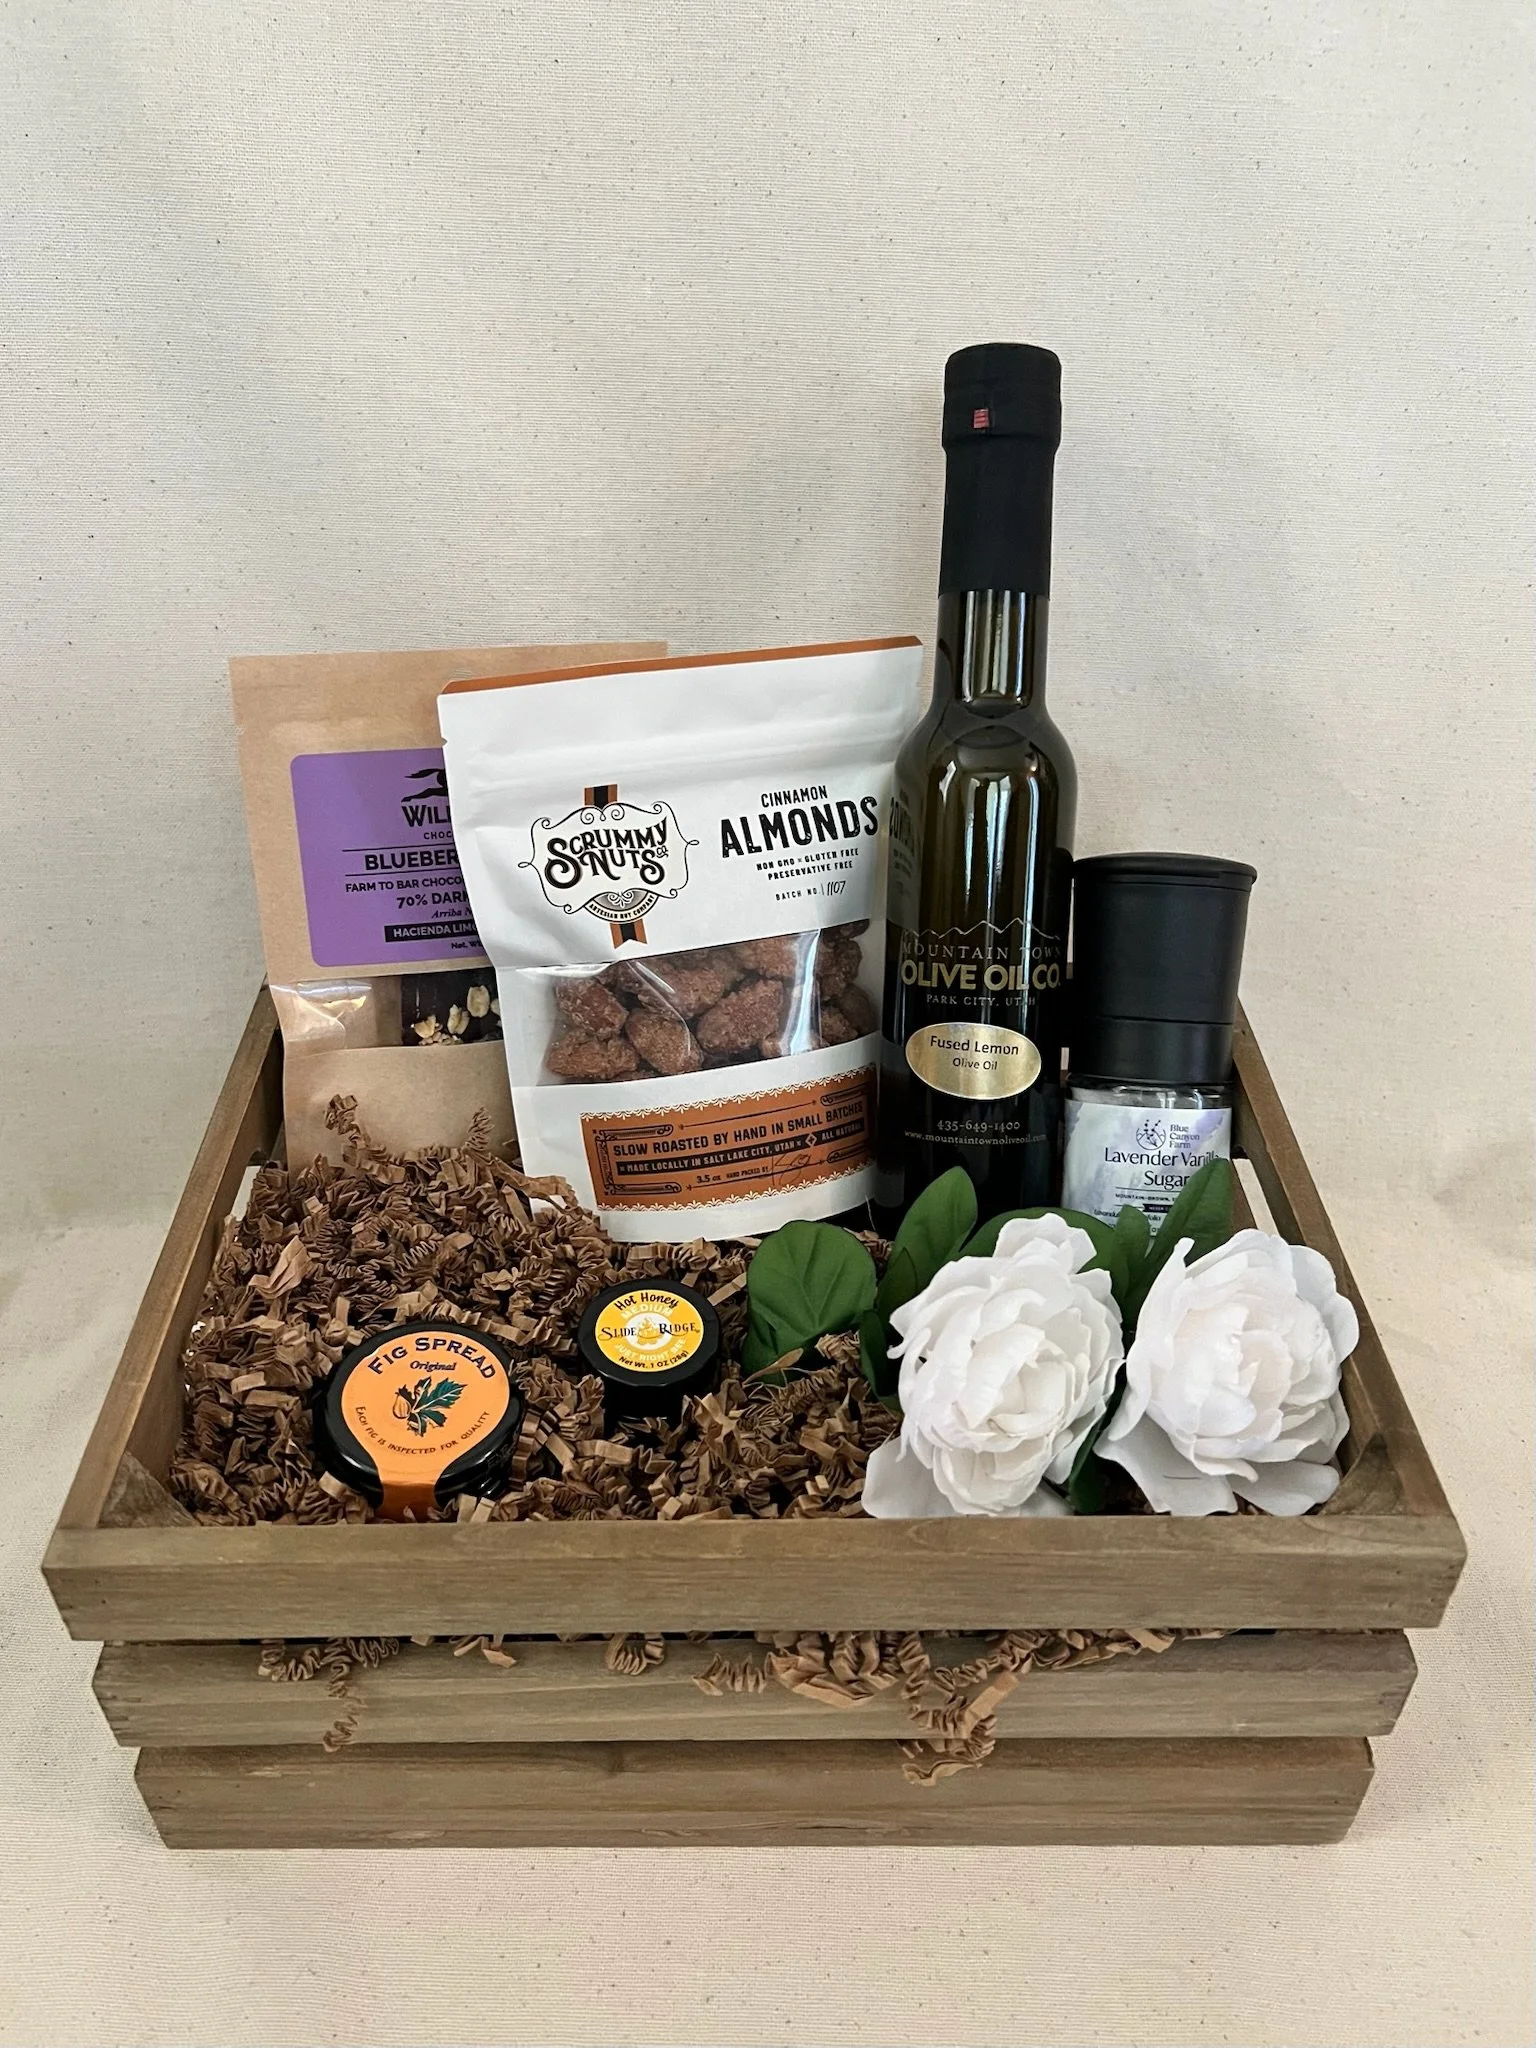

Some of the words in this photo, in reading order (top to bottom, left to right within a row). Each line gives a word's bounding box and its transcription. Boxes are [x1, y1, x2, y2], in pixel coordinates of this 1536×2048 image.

[761, 785, 828, 808] CINNAMON
[721, 796, 879, 858] ALMONDS
[544, 816, 668, 889] SCRUMMY
[756, 861, 775, 871] NON
[777, 858, 795, 867] GMO
[804, 851, 838, 863] GLUTEN
[840, 847, 859, 858] FREE
[577, 848, 666, 886] NUTS
[767, 863, 832, 880] PRESERVATIVE
[834, 860, 854, 870] FREE
[345, 882, 377, 893] FARM
[378, 880, 394, 891] TO
[396, 879, 420, 890] BAR
[775, 889, 803, 901] BATCH
[396, 893, 429, 910] 70%
[632, 894, 656, 916] COMPANY
[431, 908, 462, 919] Arriba
[393, 924, 452, 938] HACIENDA
[902, 942, 1009, 961] MOUNTAIN
[901, 958, 978, 991] OLIVE
[983, 963, 1030, 992] OIL
[926, 993, 958, 1006] PARK
[1005, 996, 1036, 1007] UTH
[930, 1035, 970, 1052] Fused
[974, 1040, 1020, 1056] Lemon
[952, 1057, 980, 1070] Olive
[982, 1060, 998, 1071] Oil
[613, 1143, 648, 1157] SLOW
[652, 1135, 709, 1154] ROASTED
[713, 1131, 729, 1146] BY
[734, 1124, 767, 1143] HAND
[771, 1120, 784, 1135] IN
[787, 1113, 823, 1132] SMALL
[825, 1101, 864, 1122] BATCHES
[936, 1118, 1021, 1133] 435-649-1400
[1170, 1124, 1189, 1132] Blue
[1169, 1132, 1200, 1142] Canyon
[1169, 1140, 1191, 1149] Farm
[627, 1163, 649, 1173] MADE
[651, 1159, 688, 1171] LOCALLY
[691, 1158, 702, 1167] IN
[703, 1154, 724, 1165] SALT
[727, 1149, 749, 1160] LAKE
[775, 1141, 795, 1152] UTAH
[821, 1131, 834, 1140] ALL
[1104, 1147, 1179, 1167] Lavender
[696, 1174, 711, 1184] 3.5
[1143, 1170, 1190, 1190] Sugar
[614, 1295, 637, 1311] Hot
[640, 1292, 679, 1309] Honey
[598, 1326, 636, 1341] SLIDE
[659, 1322, 700, 1337] RIDGE
[367, 1345, 408, 1375] FIG
[415, 1337, 496, 1379] SPREAD
[409, 1360, 457, 1373] Original
[618, 1356, 633, 1367] Net
[656, 1360, 670, 1368] OZ
[377, 1438, 386, 1446] IS
[387, 1442, 437, 1455] INSPECTED
[440, 1439, 459, 1451] FOR
[460, 1411, 490, 1440] QUALITY
